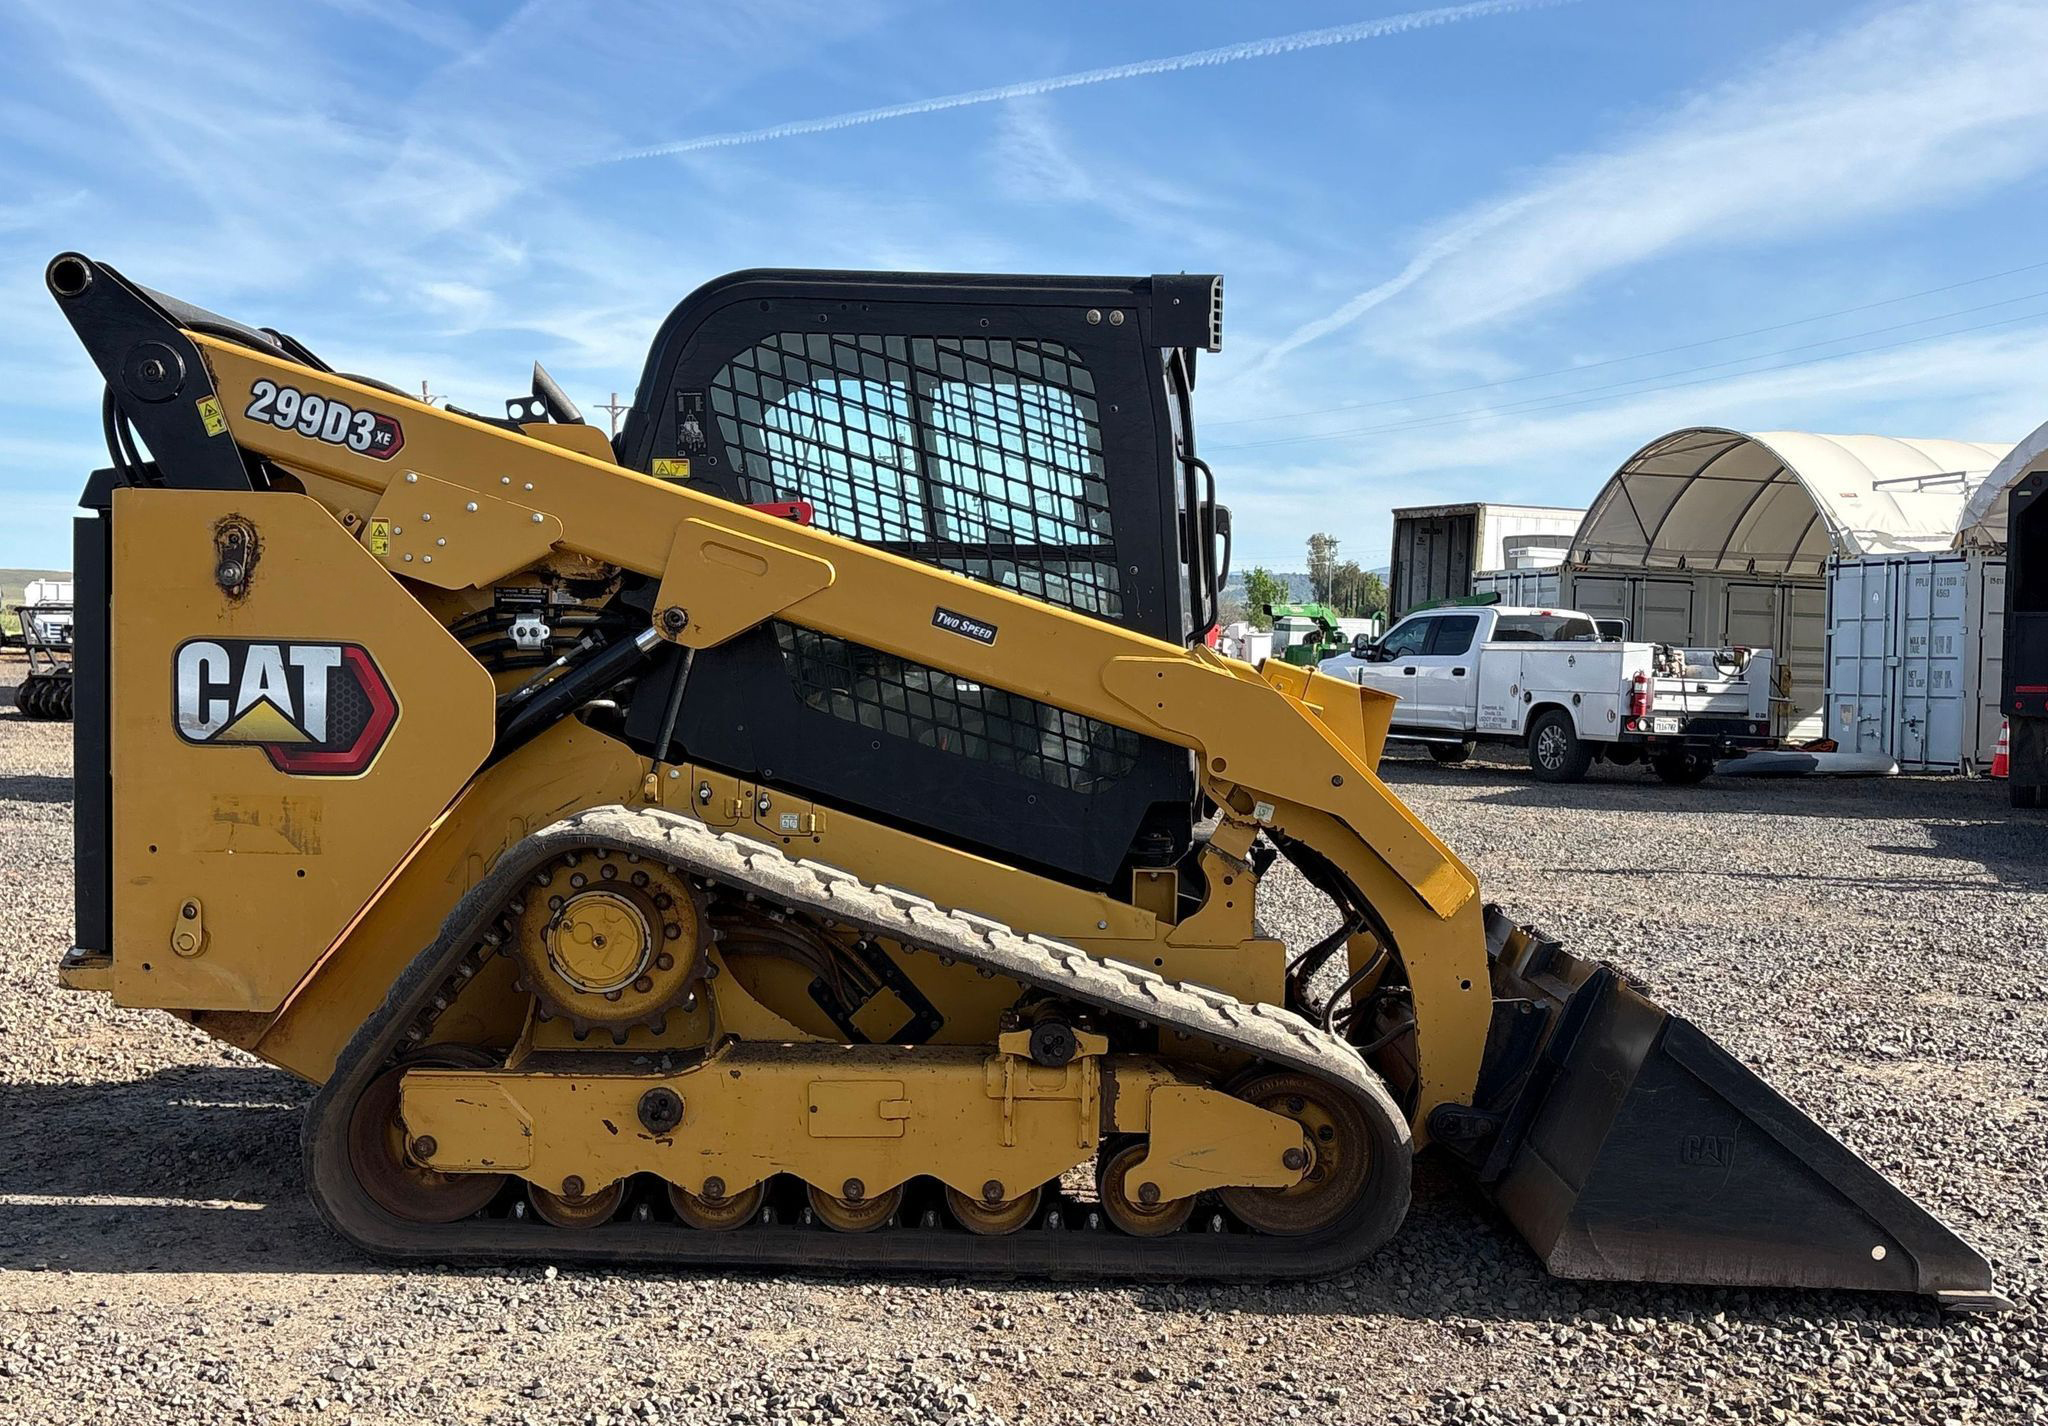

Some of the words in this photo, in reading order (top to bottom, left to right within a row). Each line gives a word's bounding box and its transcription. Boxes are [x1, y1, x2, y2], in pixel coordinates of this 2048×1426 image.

[247, 381, 376, 451] 299D3
[374, 430, 392, 446] XE
[936, 612, 960, 628] TWO
[960, 620, 993, 639] SPEED
[178, 641, 342, 743] CAT
[1682, 1135, 1734, 1167] CAT
